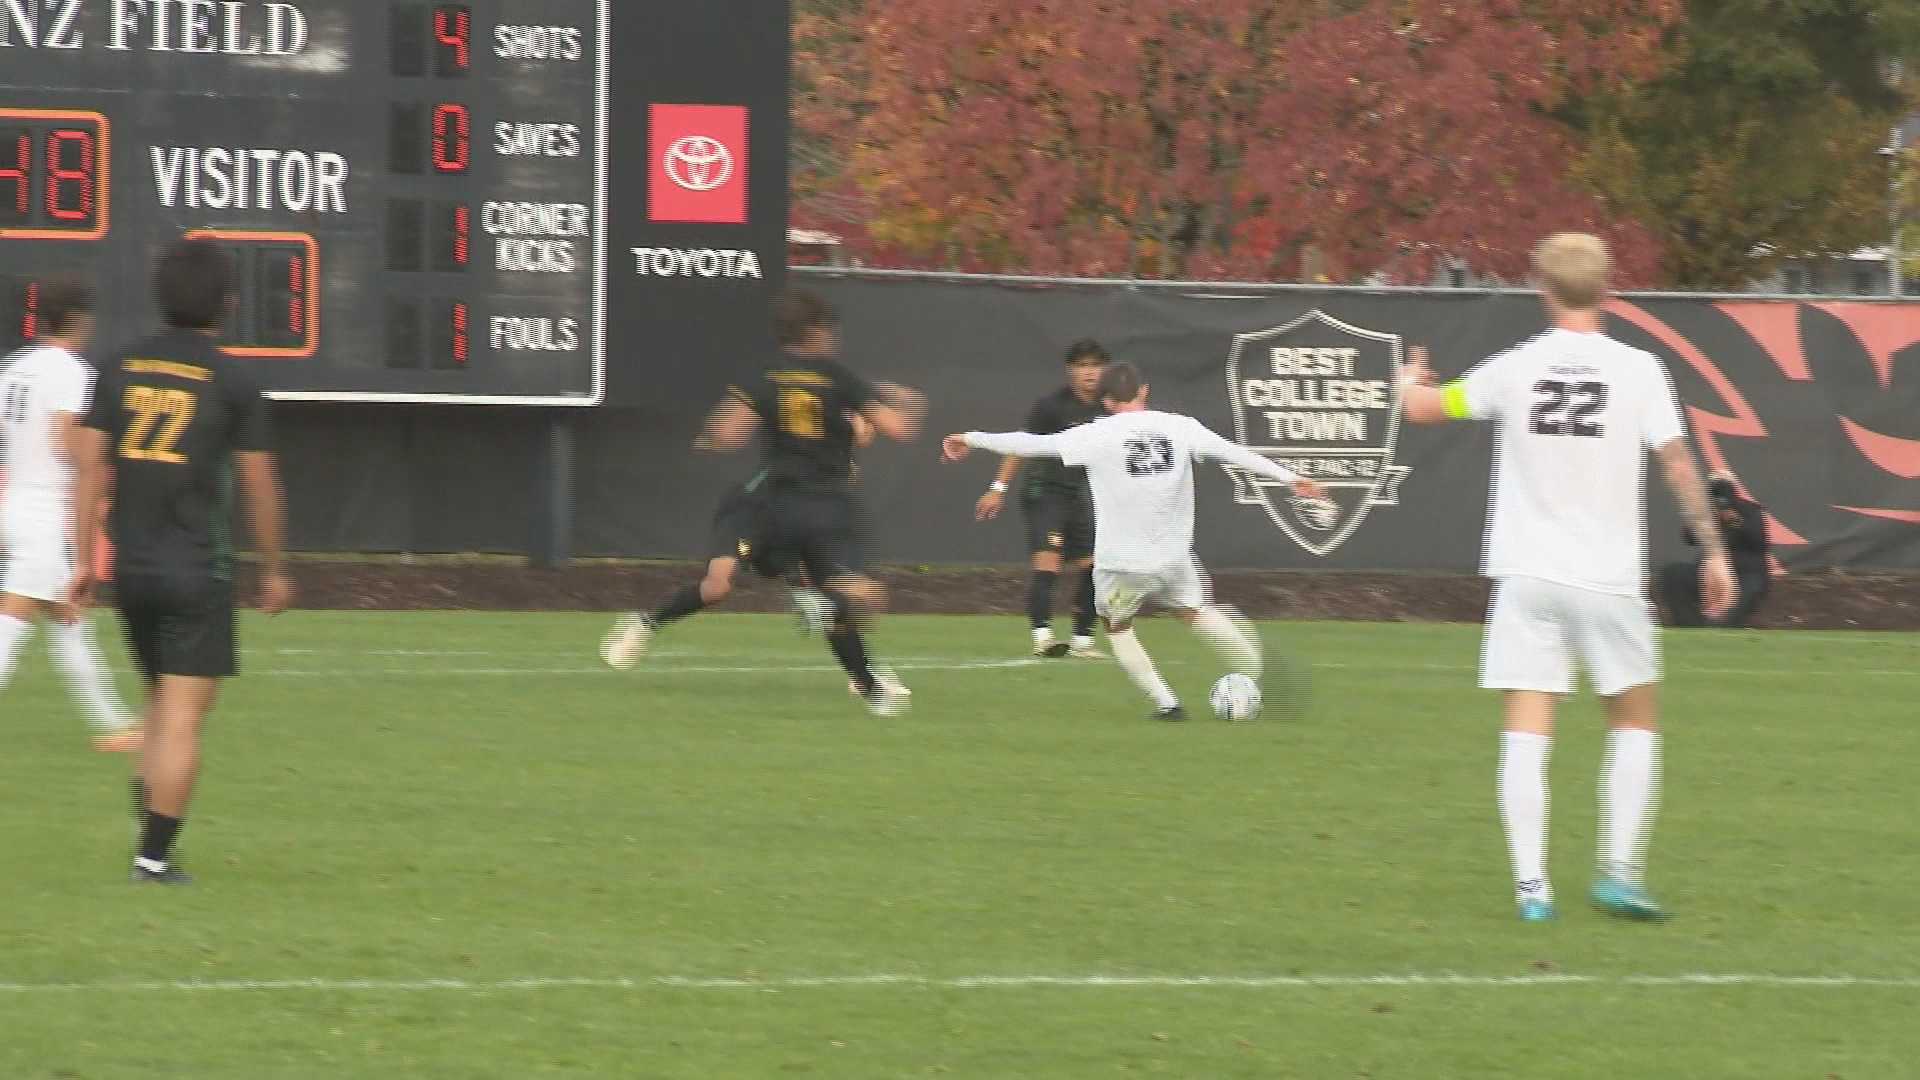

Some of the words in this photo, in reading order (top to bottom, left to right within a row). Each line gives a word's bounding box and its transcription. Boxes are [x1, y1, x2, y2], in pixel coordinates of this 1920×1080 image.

[105, 0, 309, 55] FIELD
[433, 10, 470, 69] 4
[493, 24, 582, 61] SHOTS
[431, 103, 470, 172] 0
[493, 121, 581, 157] SAVES
[149, 146, 348, 213] VISITOR
[453, 206, 470, 263] 1
[481, 201, 590, 237] CORNER
[495, 238, 575, 273] KICKS
[630, 247, 763, 279] TOYOTA
[453, 303, 469, 361] 1
[489, 316, 579, 351] FOULS
[1269, 347, 1360, 376] BEST
[1242, 379, 1390, 409] COLLEGE
[1528, 380, 1609, 438] 22
[118, 385, 198, 463] 22
[1264, 411, 1368, 441] TOWN
[1122, 437, 1175, 477] 23
